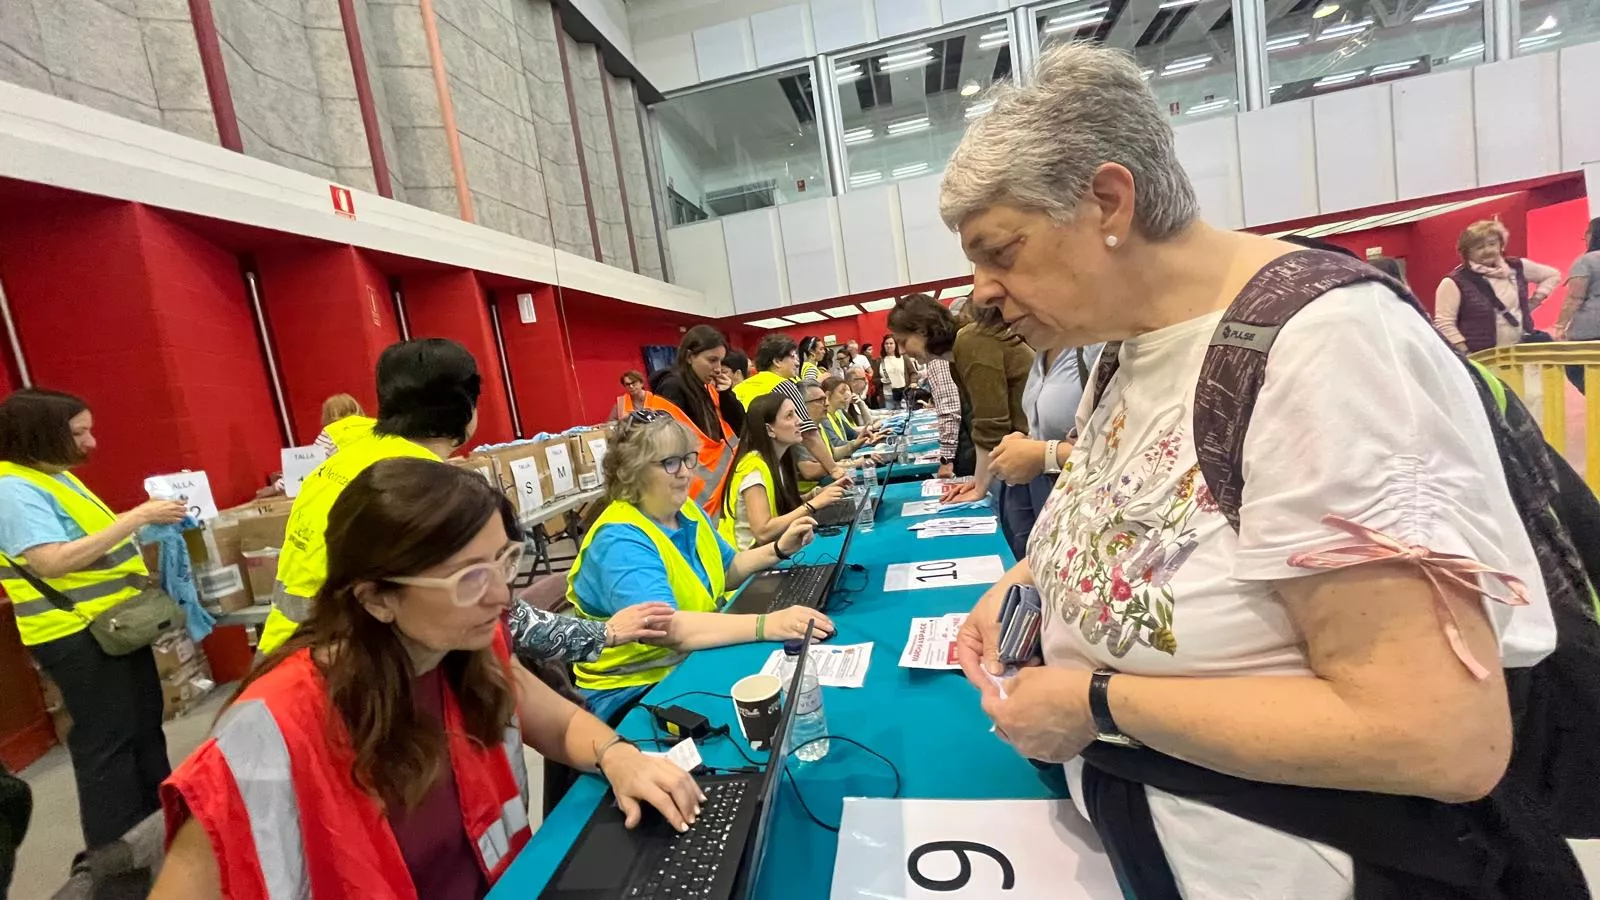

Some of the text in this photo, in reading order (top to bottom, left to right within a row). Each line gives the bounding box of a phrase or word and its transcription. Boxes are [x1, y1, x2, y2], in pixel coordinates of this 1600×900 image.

[557, 465, 566, 478] M
[172, 480, 195, 489] ALLA
[525, 481, 533, 494] S
[915, 561, 958, 582] 10
[907, 840, 1015, 892] 9
